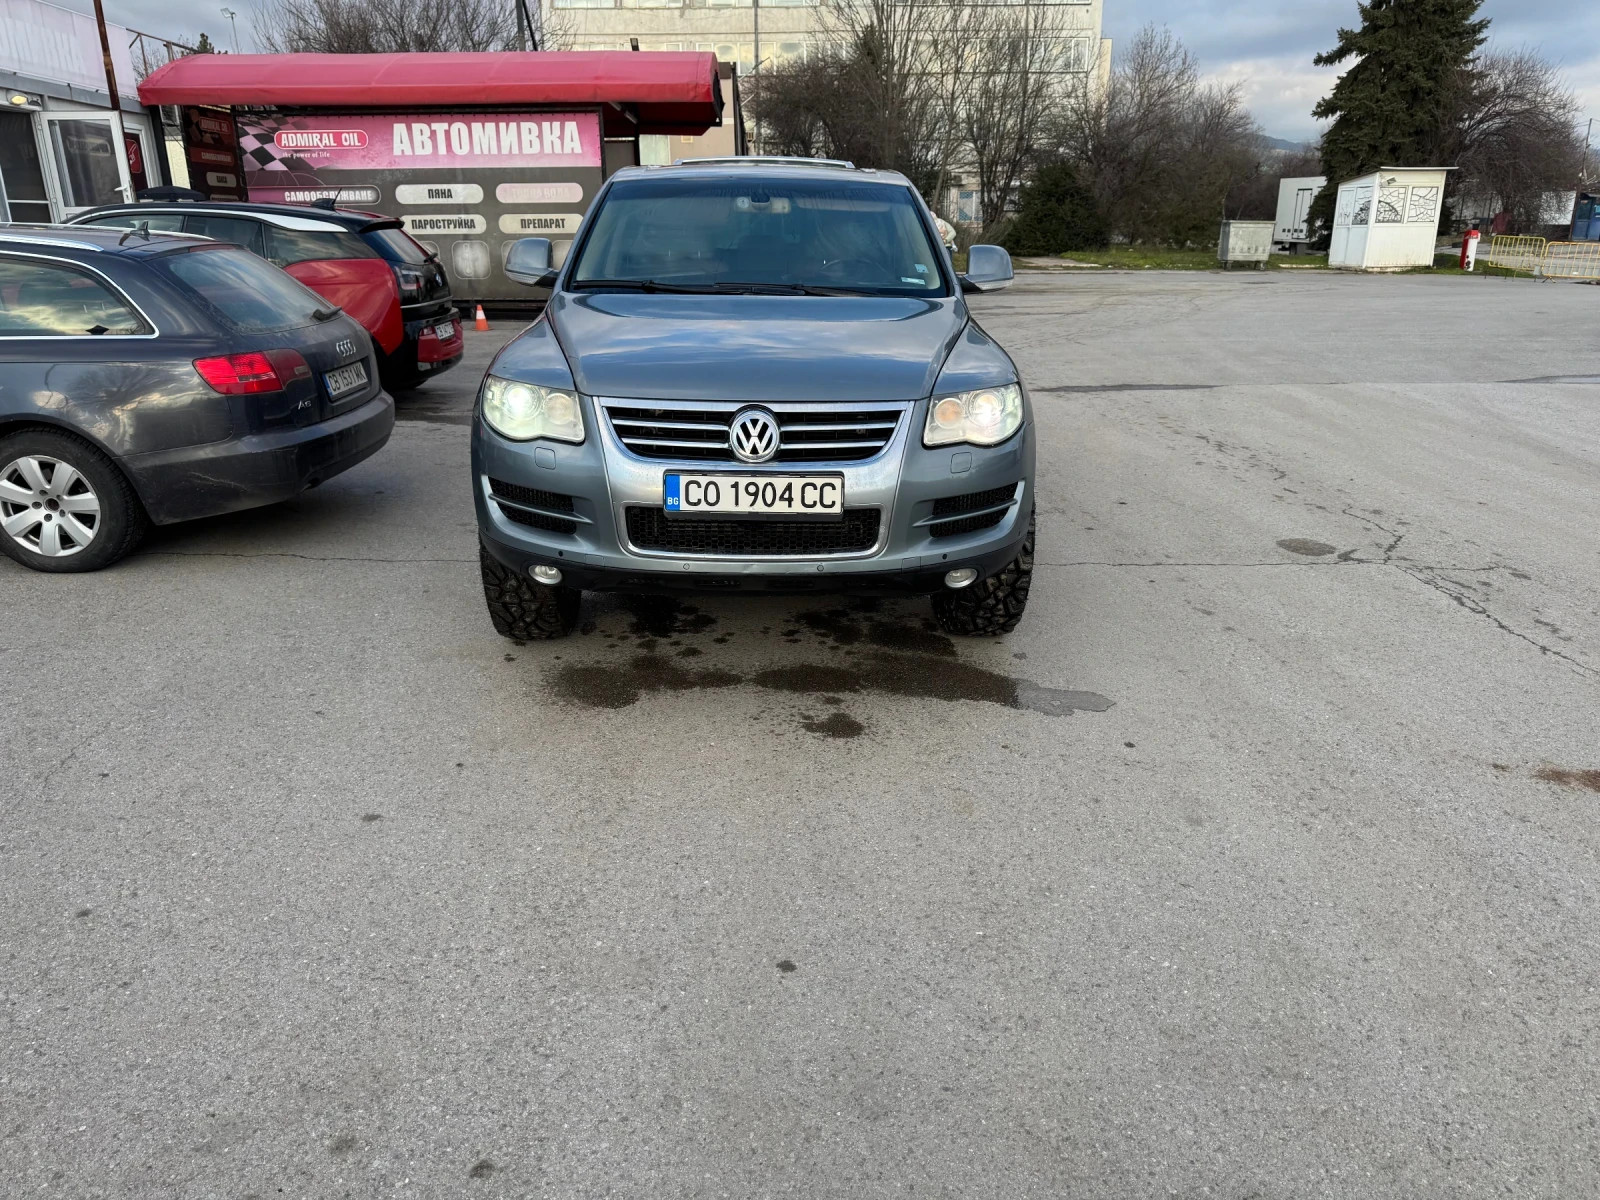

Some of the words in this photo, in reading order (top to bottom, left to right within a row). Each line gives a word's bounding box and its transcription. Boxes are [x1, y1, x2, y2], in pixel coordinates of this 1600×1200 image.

[281, 133, 337, 148] ADMIRAL
[341, 133, 361, 146] OIL
[392, 121, 583, 156] АВТОМИВКА
[427, 188, 453, 199] ПЯНА
[411, 216, 476, 230] ПАРОСТРУЙКА
[520, 218, 566, 229] ПРЕПАРАТ
[328, 373, 340, 392] CB
[735, 415, 775, 457] VW
[667, 497, 679, 505] BG
[684, 479, 721, 507] CO
[730, 481, 794, 509] 1904
[800, 482, 837, 509] CC
